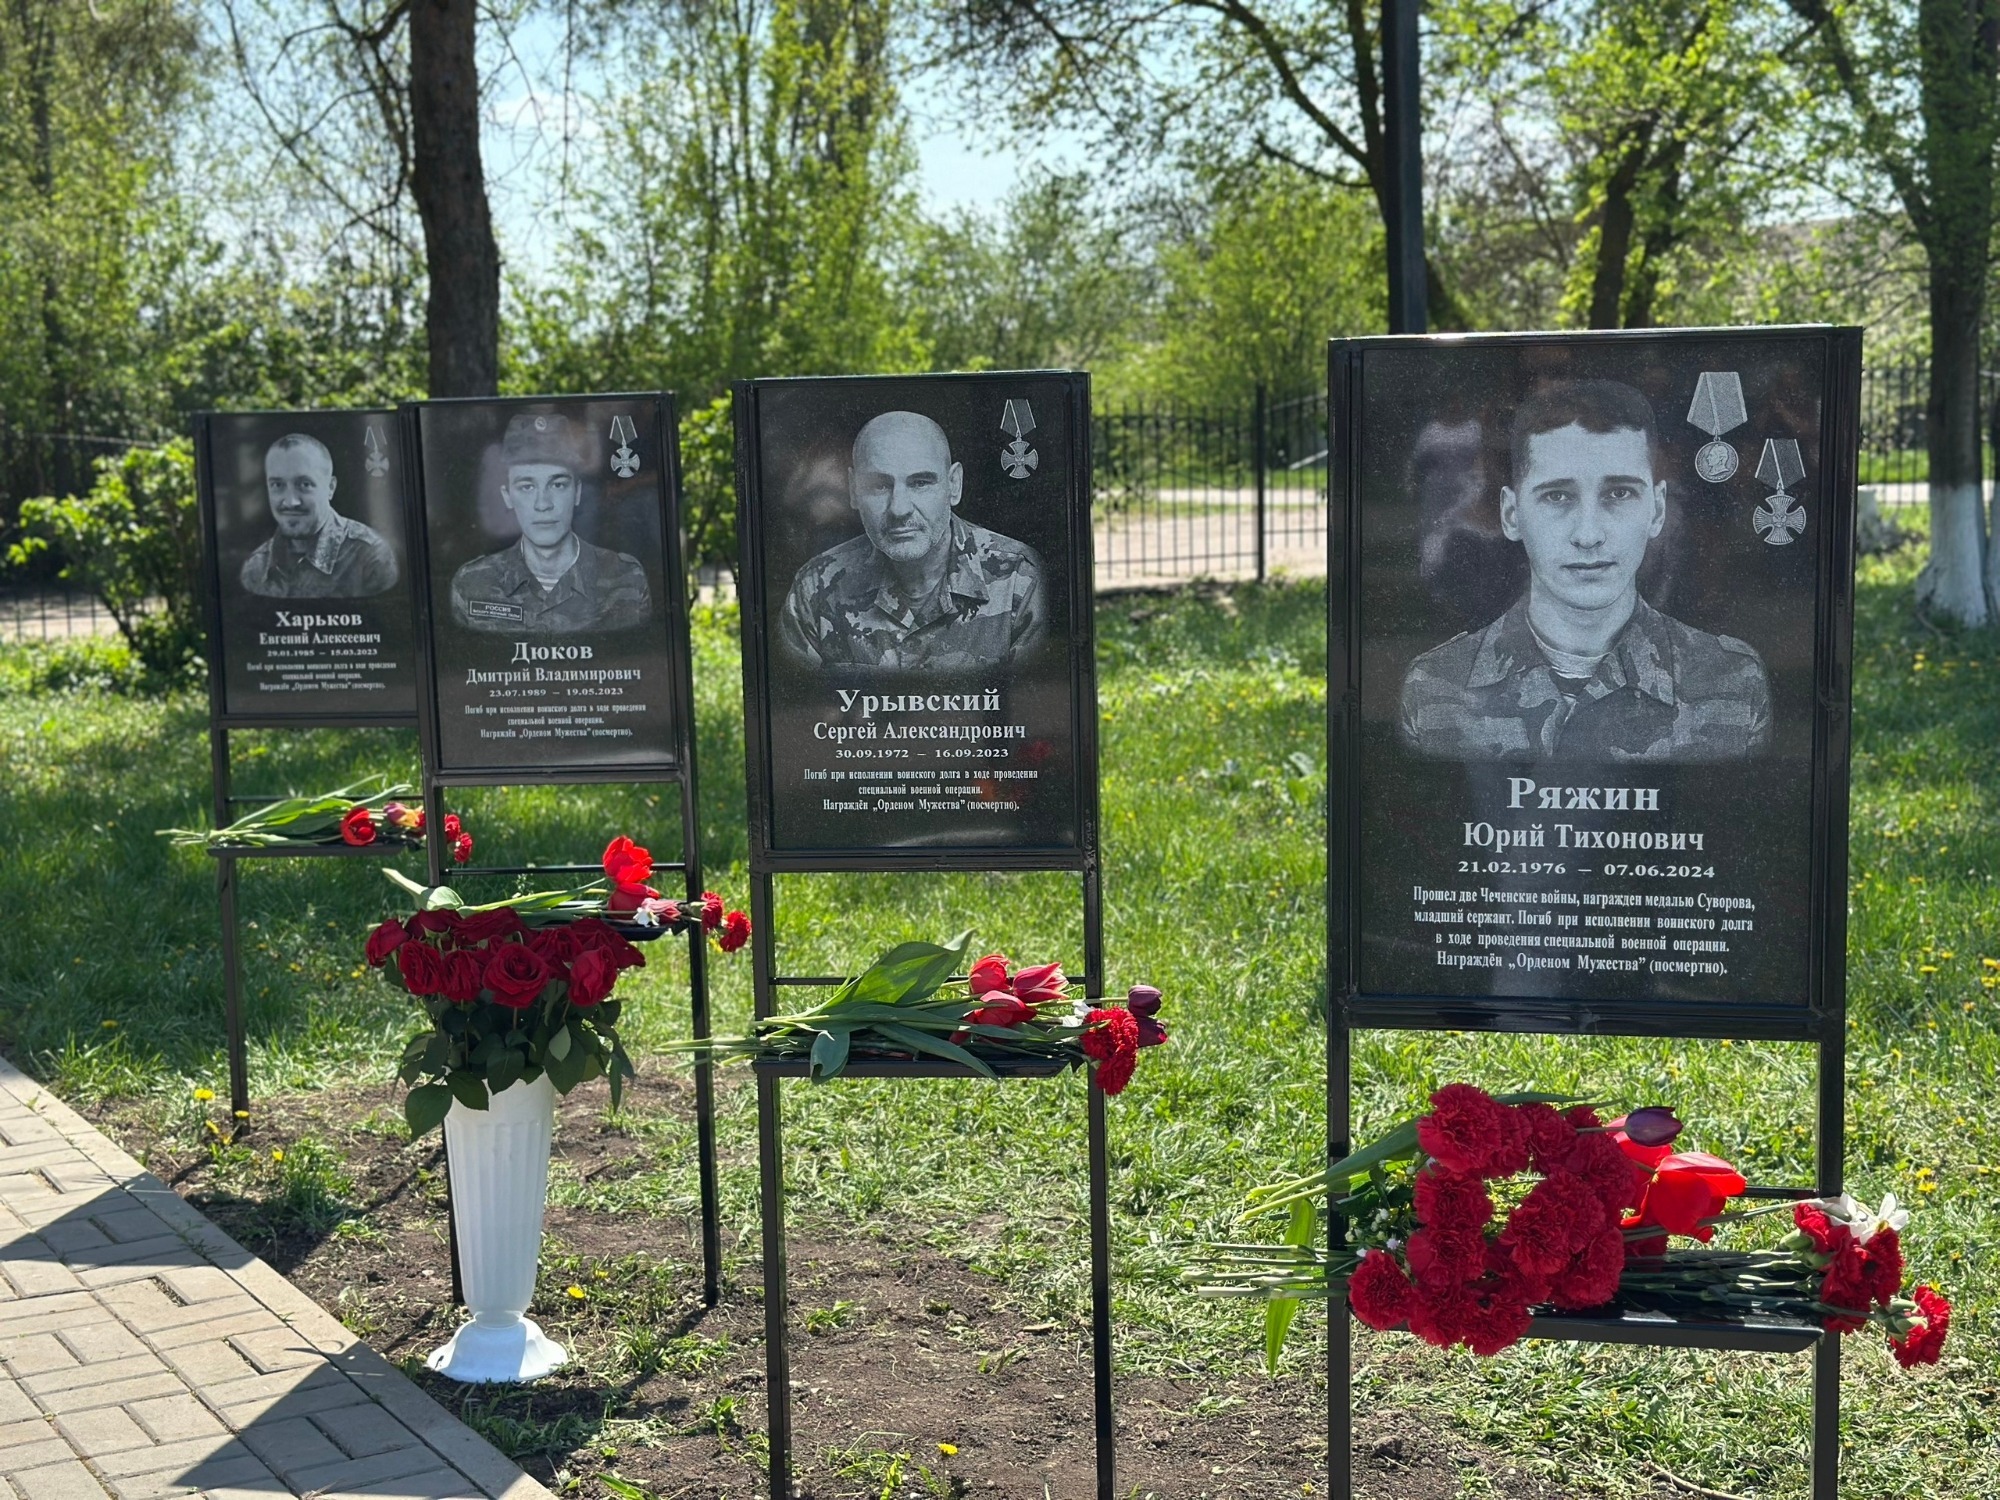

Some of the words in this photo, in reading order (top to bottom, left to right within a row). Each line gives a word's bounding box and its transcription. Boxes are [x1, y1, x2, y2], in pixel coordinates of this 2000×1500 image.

[276, 612, 362, 630] Харьков
[260, 633, 309, 644] Евгений
[313, 633, 380, 643] Алексеевич
[512, 643, 593, 663] Дюков
[466, 668, 530, 685] Дмитрий
[536, 668, 640, 684] Владимирович
[490, 689, 546, 697] 23.07.1989
[465, 705, 483, 714] Погиб
[486, 707, 497, 715] при
[612, 705, 646, 713] проведения
[836, 688, 1000, 718] Урывский
[508, 716, 545, 725] специальной
[548, 716, 572, 724] военной
[481, 729, 516, 739] Награждён
[592, 728, 632, 738] (посмертно).
[814, 722, 876, 744] Сергей
[883, 722, 1025, 743] Александрович
[836, 750, 908, 758] 30.09.1972
[936, 749, 1008, 757] 16.09.2023
[804, 769, 827, 779] Погиб
[831, 772, 844, 782] при
[897, 771, 935, 779] воинского
[940, 771, 960, 779] долга
[974, 771, 989, 779] ходе
[994, 771, 1037, 781] проведения
[859, 784, 906, 795] специальной
[911, 784, 941, 794] военной
[945, 786, 983, 797] операции.
[1507, 778, 1660, 810] Ряжин
[824, 799, 868, 813] Награждён
[967, 801, 1019, 812] (посмертно).
[1463, 822, 1544, 853] Юрий
[1554, 824, 1703, 850] Тихонович
[1459, 861, 1565, 874] 21.02.1976
[1604, 864, 1714, 877] 07.06.2024
[1414, 886, 1457, 904] Прошел
[1459, 891, 1477, 903] две
[1481, 888, 1538, 903] Чеченские
[1541, 889, 1579, 906] войны,
[1583, 894, 1642, 909] награжден
[1645, 896, 1694, 908] медалью
[1698, 893, 1755, 912] Суворова,
[1415, 909, 1463, 923] младший
[1467, 913, 1514, 927] сержант.
[1519, 910, 1551, 925] Погиб
[1558, 915, 1578, 929] при
[1585, 916, 1650, 927] исполнении
[1657, 918, 1715, 929] воинского
[1721, 920, 1752, 931] долга
[1436, 934, 1442, 943] в
[1448, 934, 1471, 945] ходе
[1478, 935, 1540, 949] проведения
[1544, 934, 1614, 948] специальной
[1622, 936, 1666, 950] военной
[1673, 940, 1729, 955] операции.
[1437, 951, 1502, 969] Награждён
[1650, 960, 1727, 976] (посмертно).
